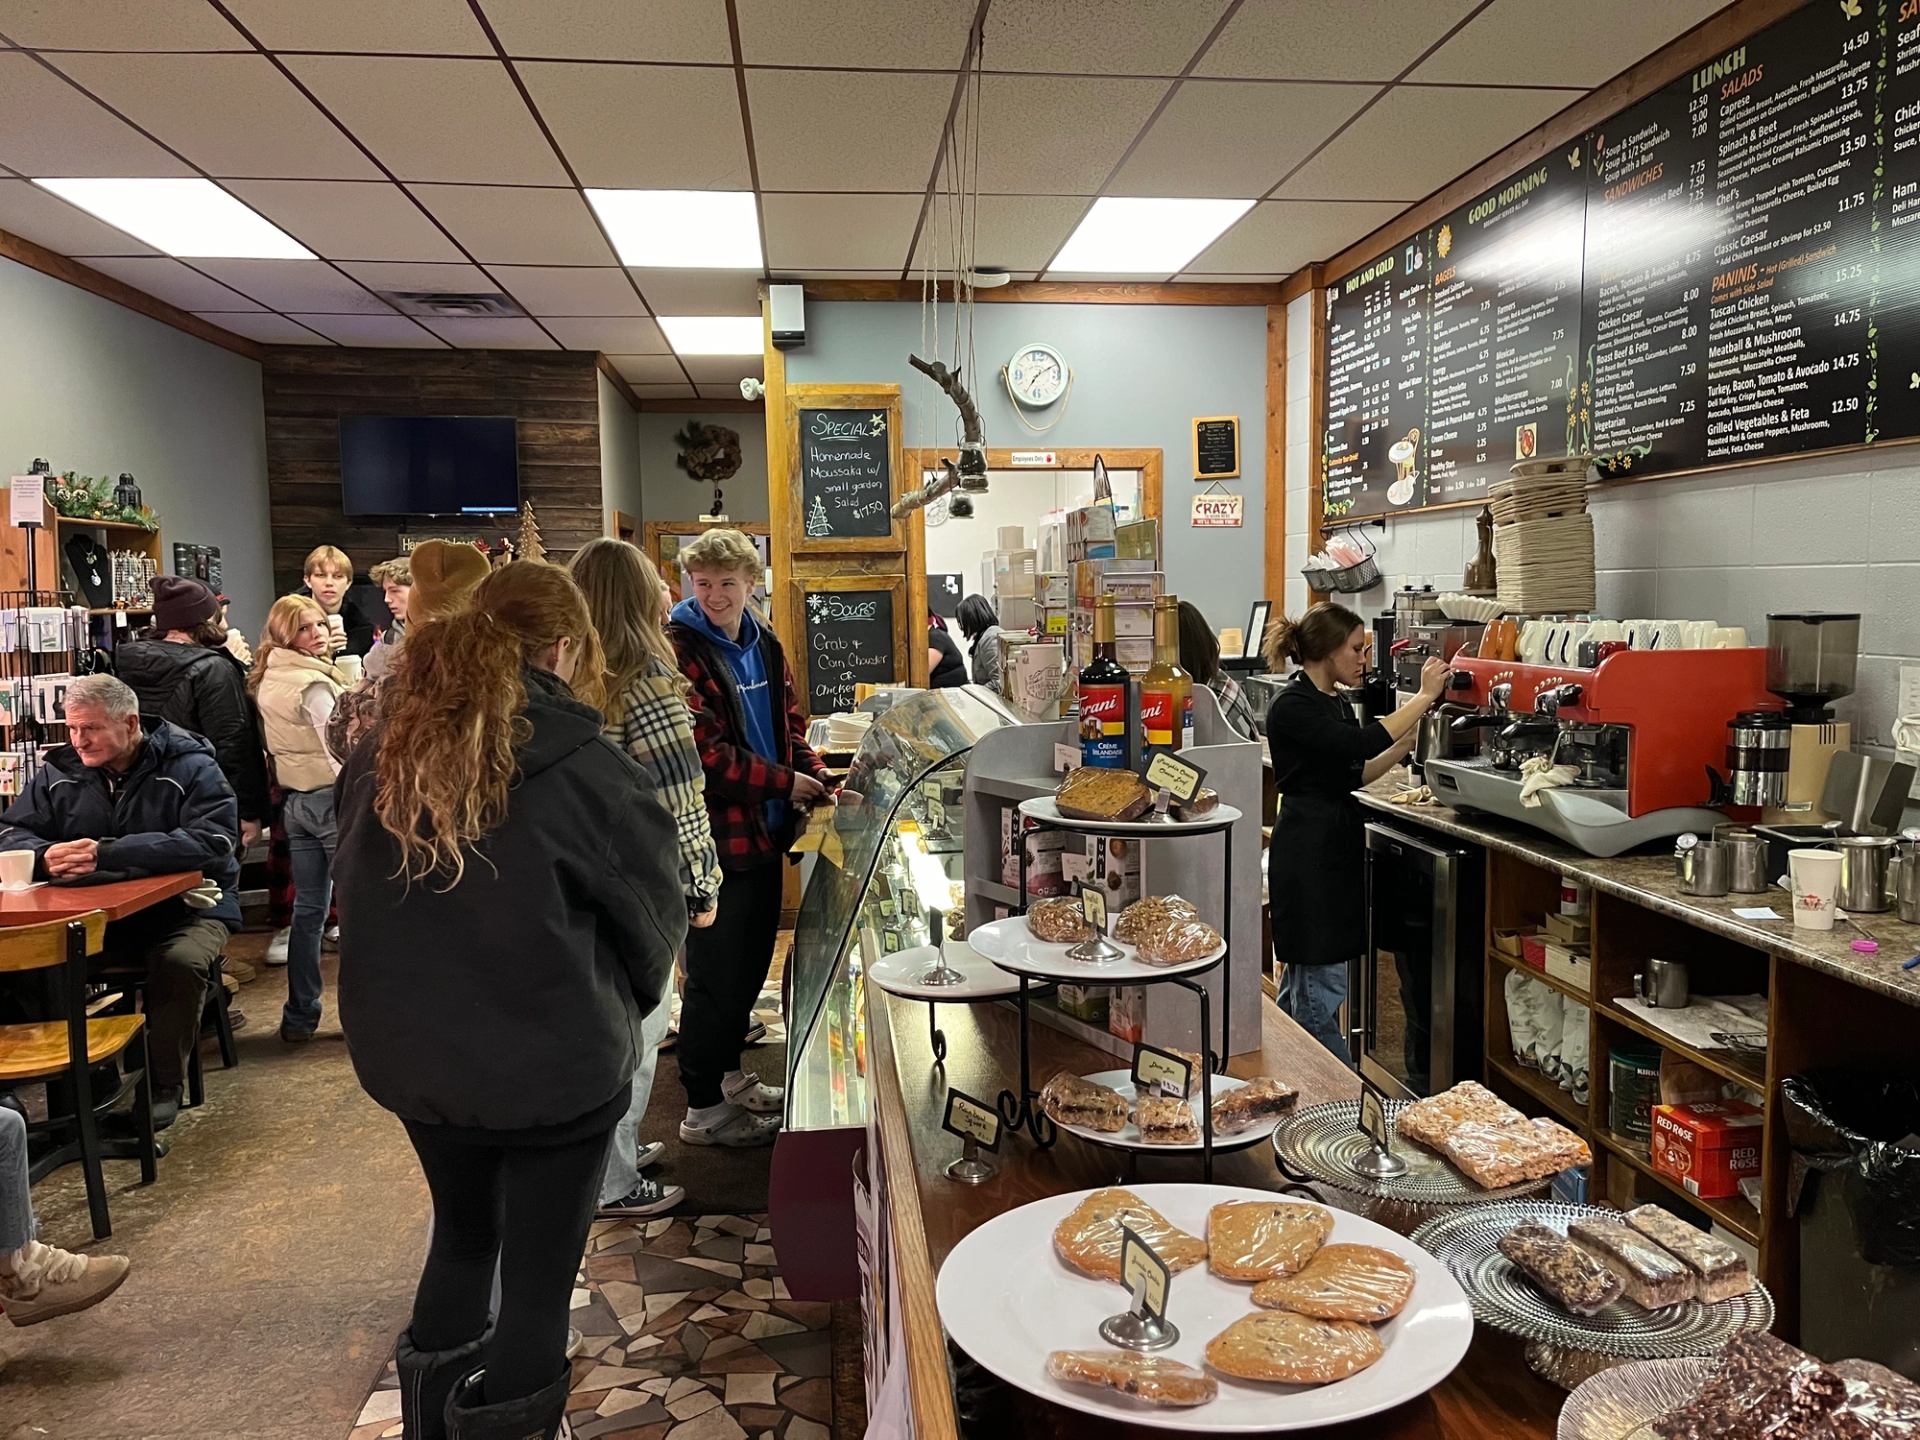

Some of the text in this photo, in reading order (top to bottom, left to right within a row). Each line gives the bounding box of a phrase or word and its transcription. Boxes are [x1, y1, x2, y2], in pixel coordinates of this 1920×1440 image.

[1898, 0, 1920, 22] SA
[1842, 31, 1869, 55] 14.50
[1692, 46, 1746, 94] LUNCH
[1720, 64, 1763, 100] SALADS
[1841, 76, 1869, 100] 13.75
[1688, 94, 1708, 113] 12.50
[1720, 94, 1750, 117] Caprese
[1691, 108, 1708, 125] 9.00
[1606, 122, 1658, 159] Soup & Sandwich
[1691, 122, 1708, 138] 7.00
[1718, 98, 1858, 168] Homemade Beet Salad over Fresh Spinach Leaves
[1718, 120, 1778, 157] Spinach & Beet
[1605, 128, 1670, 172] Soup & 1/2 Sandwich
[1717, 110, 1864, 178] Seasoned with Dried Cranberries, Sunflower Seeds,
[1840, 134, 1867, 156] 13.50
[1894, 137, 1917, 153] Sauce,
[1604, 170, 1620, 184] Soup
[1621, 162, 1634, 176] with
[1641, 152, 1654, 166] Bun
[1690, 160, 1706, 176] 7.75
[1604, 162, 1664, 203] SANDWICHES
[1690, 174, 1705, 190] 7.50
[1756, 158, 1850, 202] Topped with Tomato, Cucumber,
[1468, 166, 1548, 225] GOOD MORNING
[1689, 188, 1704, 204] 7.25
[1716, 188, 1740, 206] Chef's
[1892, 182, 1917, 200] Ham
[1838, 192, 1865, 213] 11.75
[1714, 229, 1768, 258] Classic Caesar
[1346, 276, 1360, 295] HOT
[1360, 267, 1375, 286] AND
[1375, 256, 1394, 278] COLD
[1434, 265, 1456, 286] BAGELS
[1711, 262, 1758, 293] PANINIS
[1766, 263, 1778, 274] Hot
[1836, 264, 1862, 283] 15.25
[1683, 287, 1700, 302] 8.00
[1710, 276, 1774, 305] Comes with Side Salad
[1622, 310, 1643, 324] Caesar
[1710, 294, 1770, 320] Tuscan Chicken
[1834, 308, 1861, 327] 14.75
[1682, 325, 1698, 340] 8.00
[1708, 326, 1802, 359] Meatball & Mushroom
[1596, 352, 1613, 365] Roast
[1614, 345, 1628, 360] Beef
[1635, 342, 1649, 354] Feta
[1832, 354, 1860, 371] 14.75
[1680, 362, 1696, 377] 7.50
[1708, 353, 1798, 380] Mushrooms, Mozzarella Cheese
[1595, 379, 1634, 399] Turkey Ranch
[1708, 360, 1830, 397] Turkey, Bacon, Tomato & Avocado
[1680, 400, 1696, 414] 7.25
[1708, 398, 1784, 420] Avocado, Mozzarella Cheese
[1832, 396, 1859, 414] 12.50
[811, 413, 870, 436] SPECIAL
[1594, 416, 1626, 433] Vegetarian
[1708, 408, 1810, 436] Grilled Vegetables & Feta
[1708, 418, 1830, 447] Roasted Red Green Peppers, Mushrooms,
[810, 446, 872, 462] Homemade
[810, 466, 862, 479] Moussaka
[852, 481, 882, 496] garden
[834, 496, 860, 508] Salad
[1196, 503, 1238, 514] CRAZY
[814, 632, 848, 651] Crab
[1141, 701, 1162, 720] ani
[1012, 814, 1020, 850] NUMI
[1656, 1115, 1672, 1131] RED
[1673, 1124, 1694, 1143] ROSE
[1730, 1157, 1759, 1170] ROSE
[1732, 1147, 1756, 1160] RED
